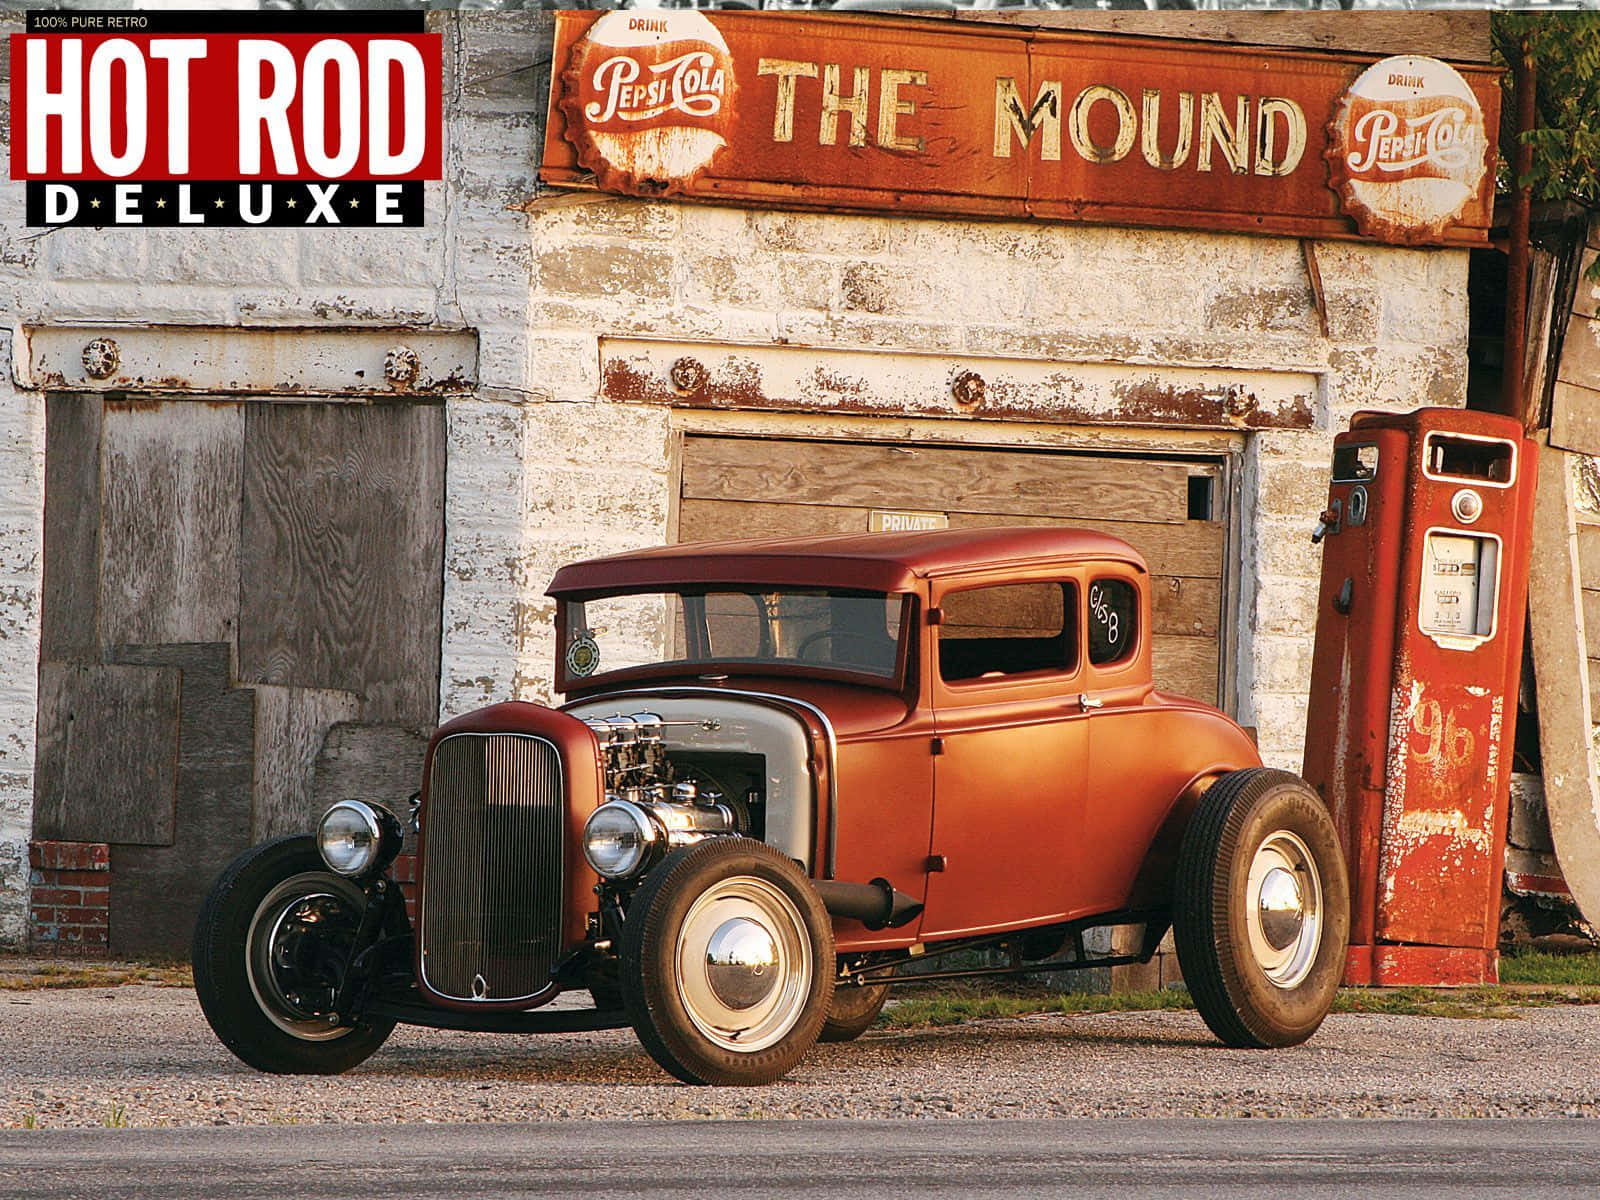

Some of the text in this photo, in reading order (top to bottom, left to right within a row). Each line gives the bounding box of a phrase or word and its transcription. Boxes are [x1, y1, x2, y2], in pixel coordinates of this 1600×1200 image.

[628, 17, 669, 33] DRINK
[1388, 73, 1425, 90] DRINK
[757, 58, 1308, 176] THE MOUND
